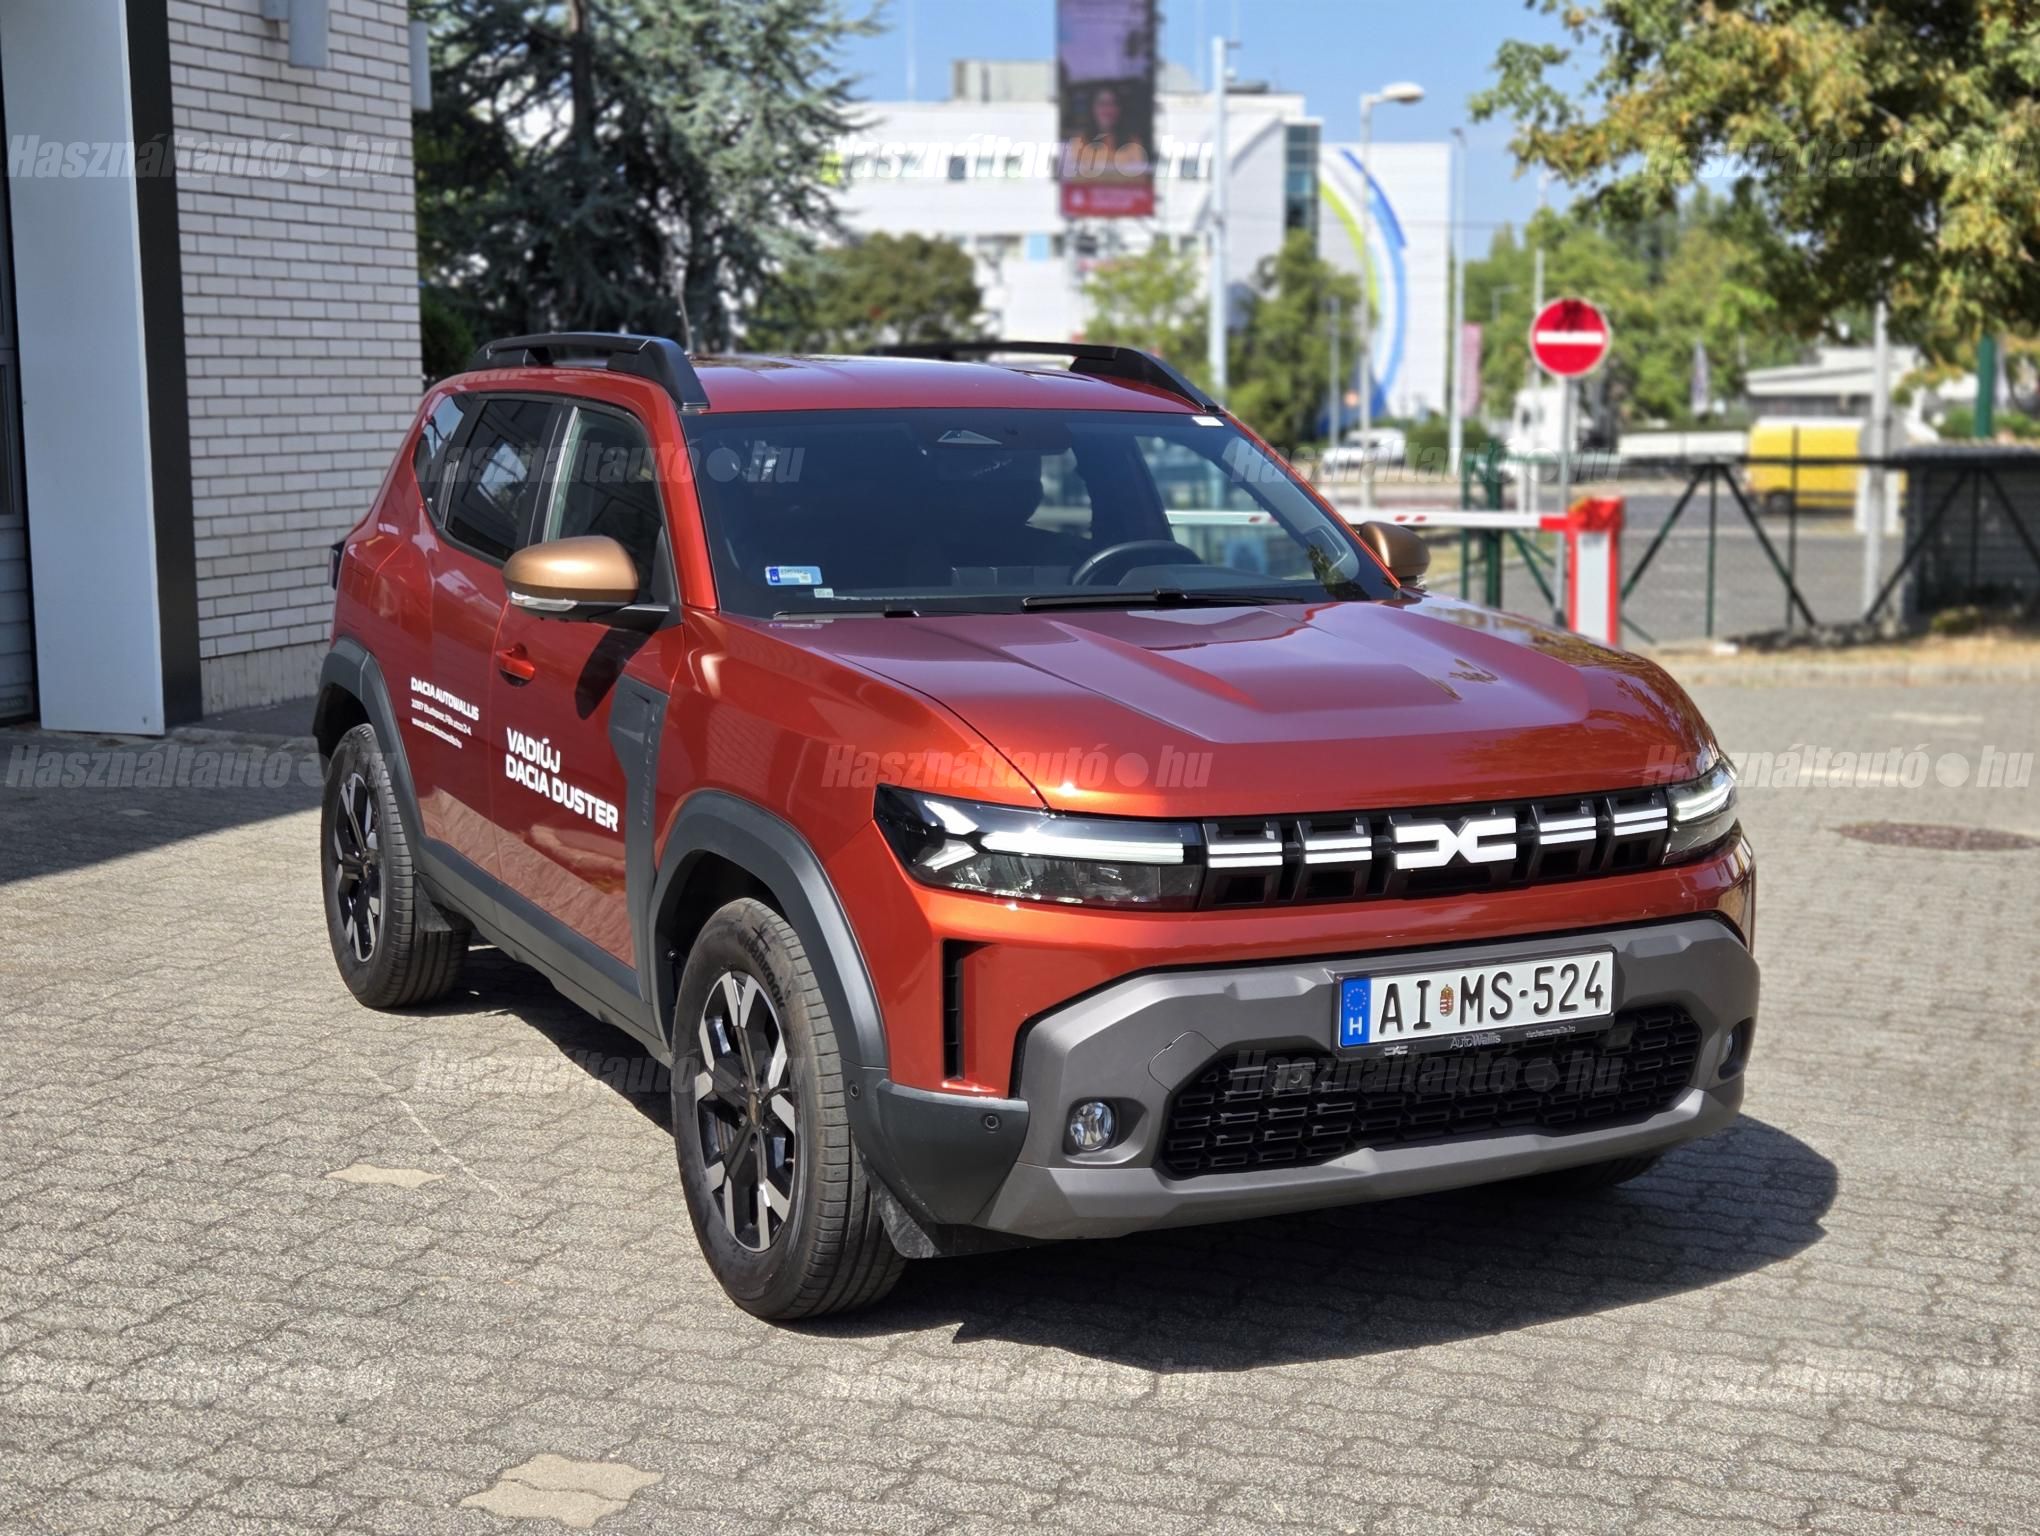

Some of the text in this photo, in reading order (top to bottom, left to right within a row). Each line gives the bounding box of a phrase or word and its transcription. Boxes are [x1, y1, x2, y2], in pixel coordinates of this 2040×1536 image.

[411, 677, 436, 699] DACIA
[507, 727, 561, 774] VADIÚJ
[505, 754, 619, 832] DACIA DUSTER
[1378, 979, 1432, 1035] AI
[1349, 1016, 1363, 1036] H
[1450, 1032, 1502, 1049] AutoWallis
